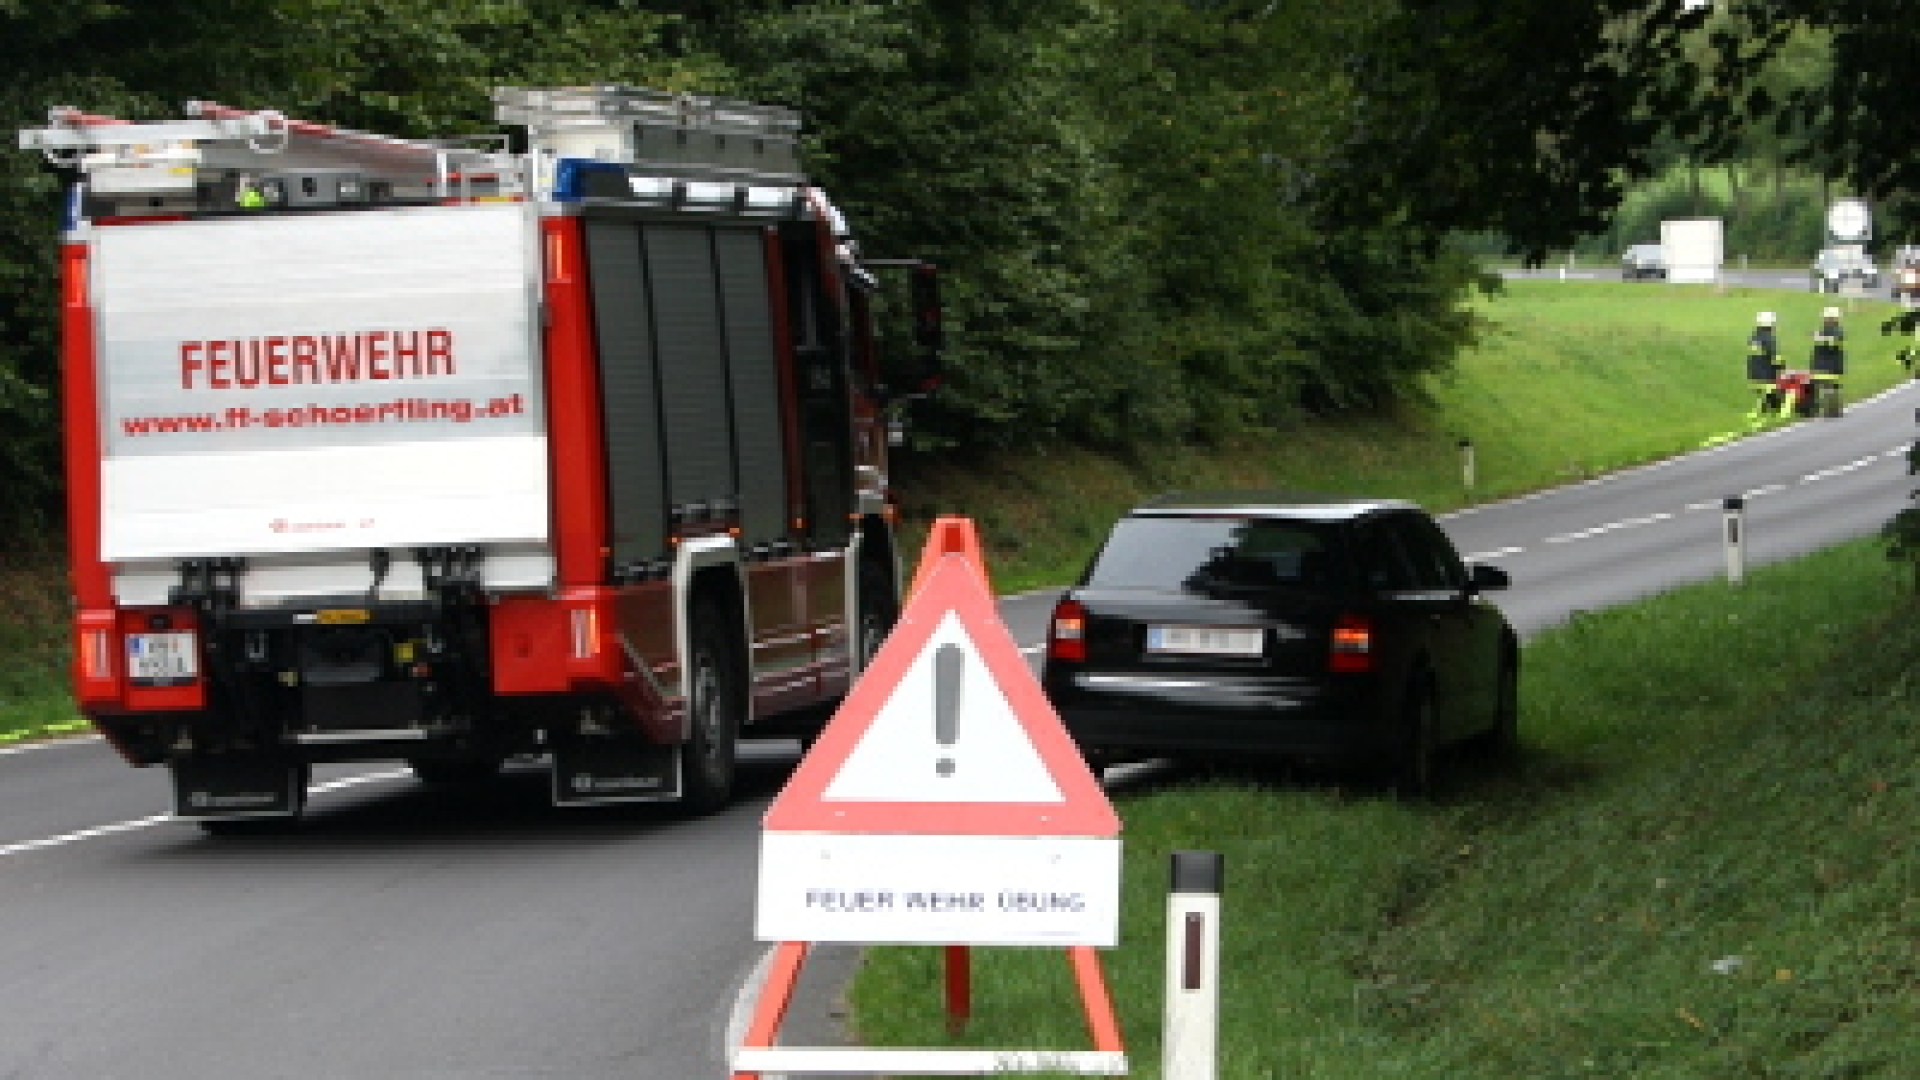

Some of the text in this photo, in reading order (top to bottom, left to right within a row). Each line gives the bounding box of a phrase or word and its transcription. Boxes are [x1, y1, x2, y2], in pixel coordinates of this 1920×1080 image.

[180, 328, 454, 389] FEUERWEHR
[123, 394, 524, 435] www.ff-schoerfling.at
[805, 888, 1087, 912] FEUER WEHR ÜBUNG
